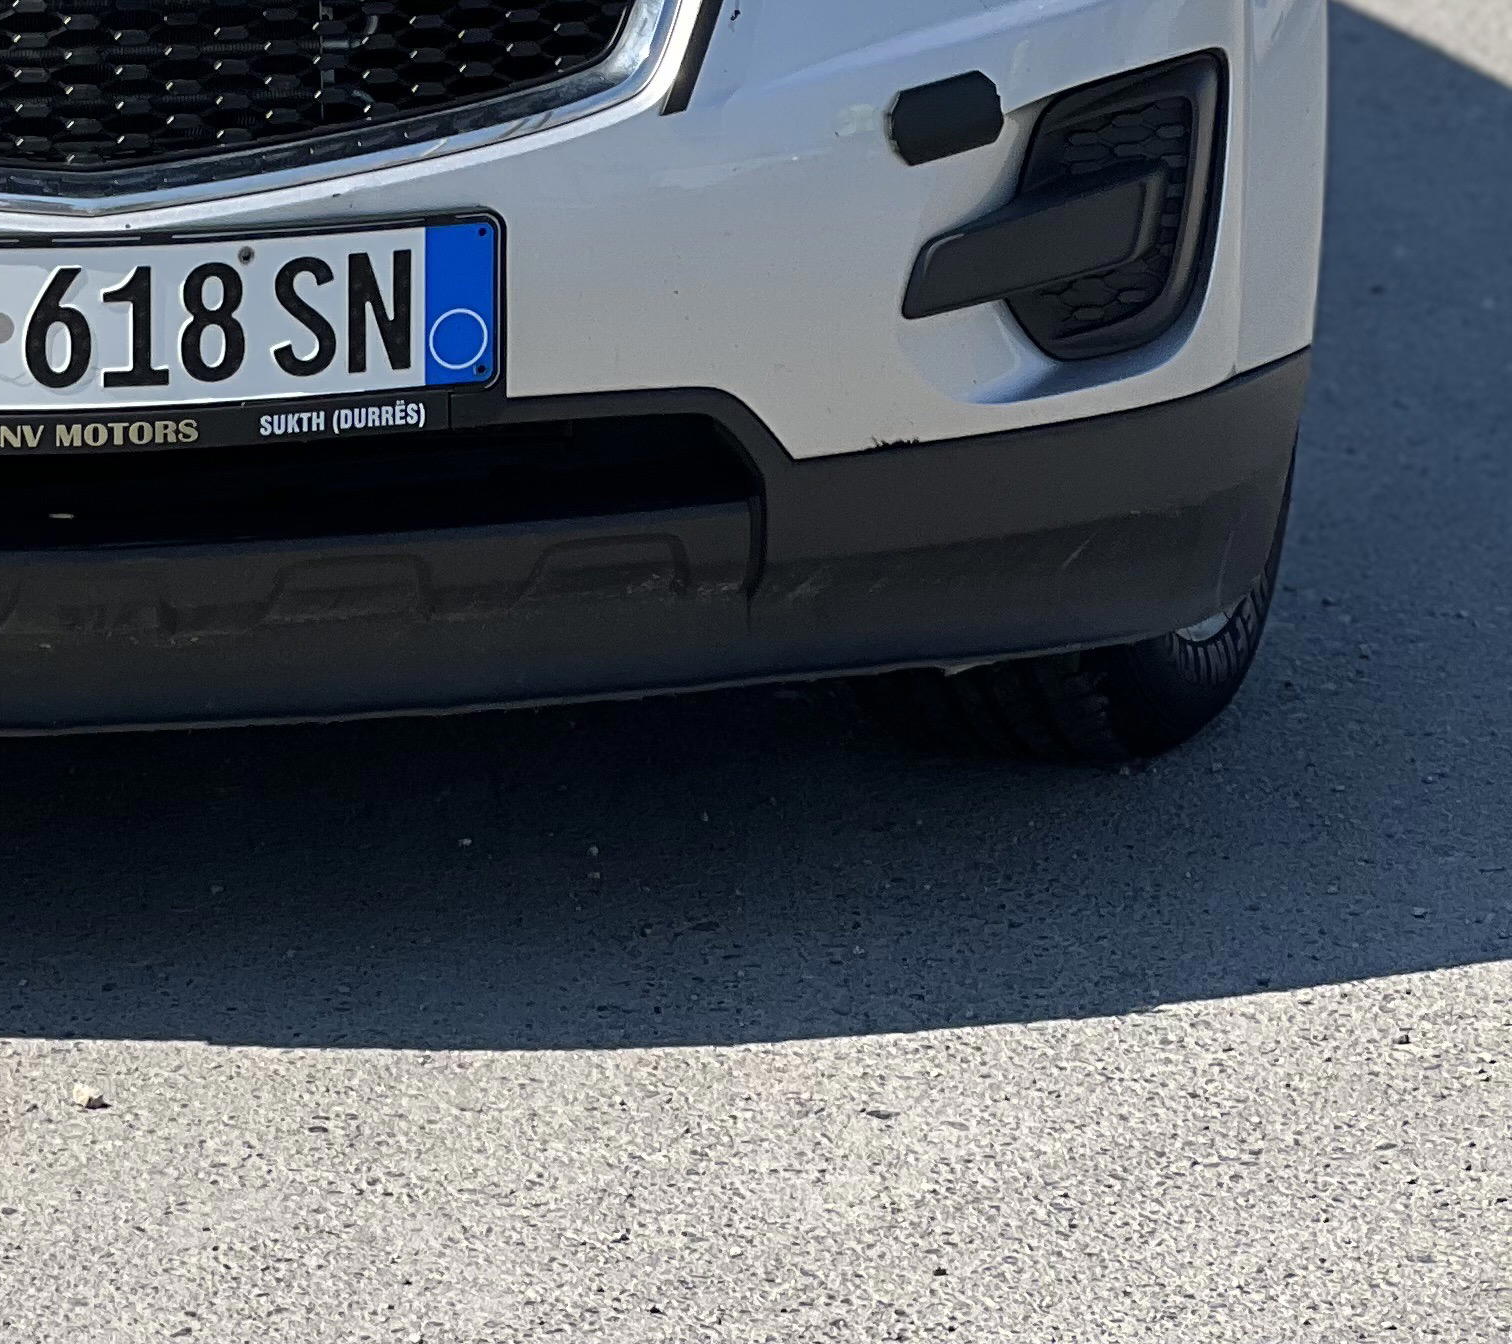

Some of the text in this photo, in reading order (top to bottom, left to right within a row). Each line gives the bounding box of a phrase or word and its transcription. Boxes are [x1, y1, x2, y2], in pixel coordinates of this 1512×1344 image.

[24, 261, 246, 389] 618
[272, 248, 412, 378] SN
[0, 418, 199, 449] NV MOTORS
[259, 399, 427, 436] SUKTH (DURRËS)
